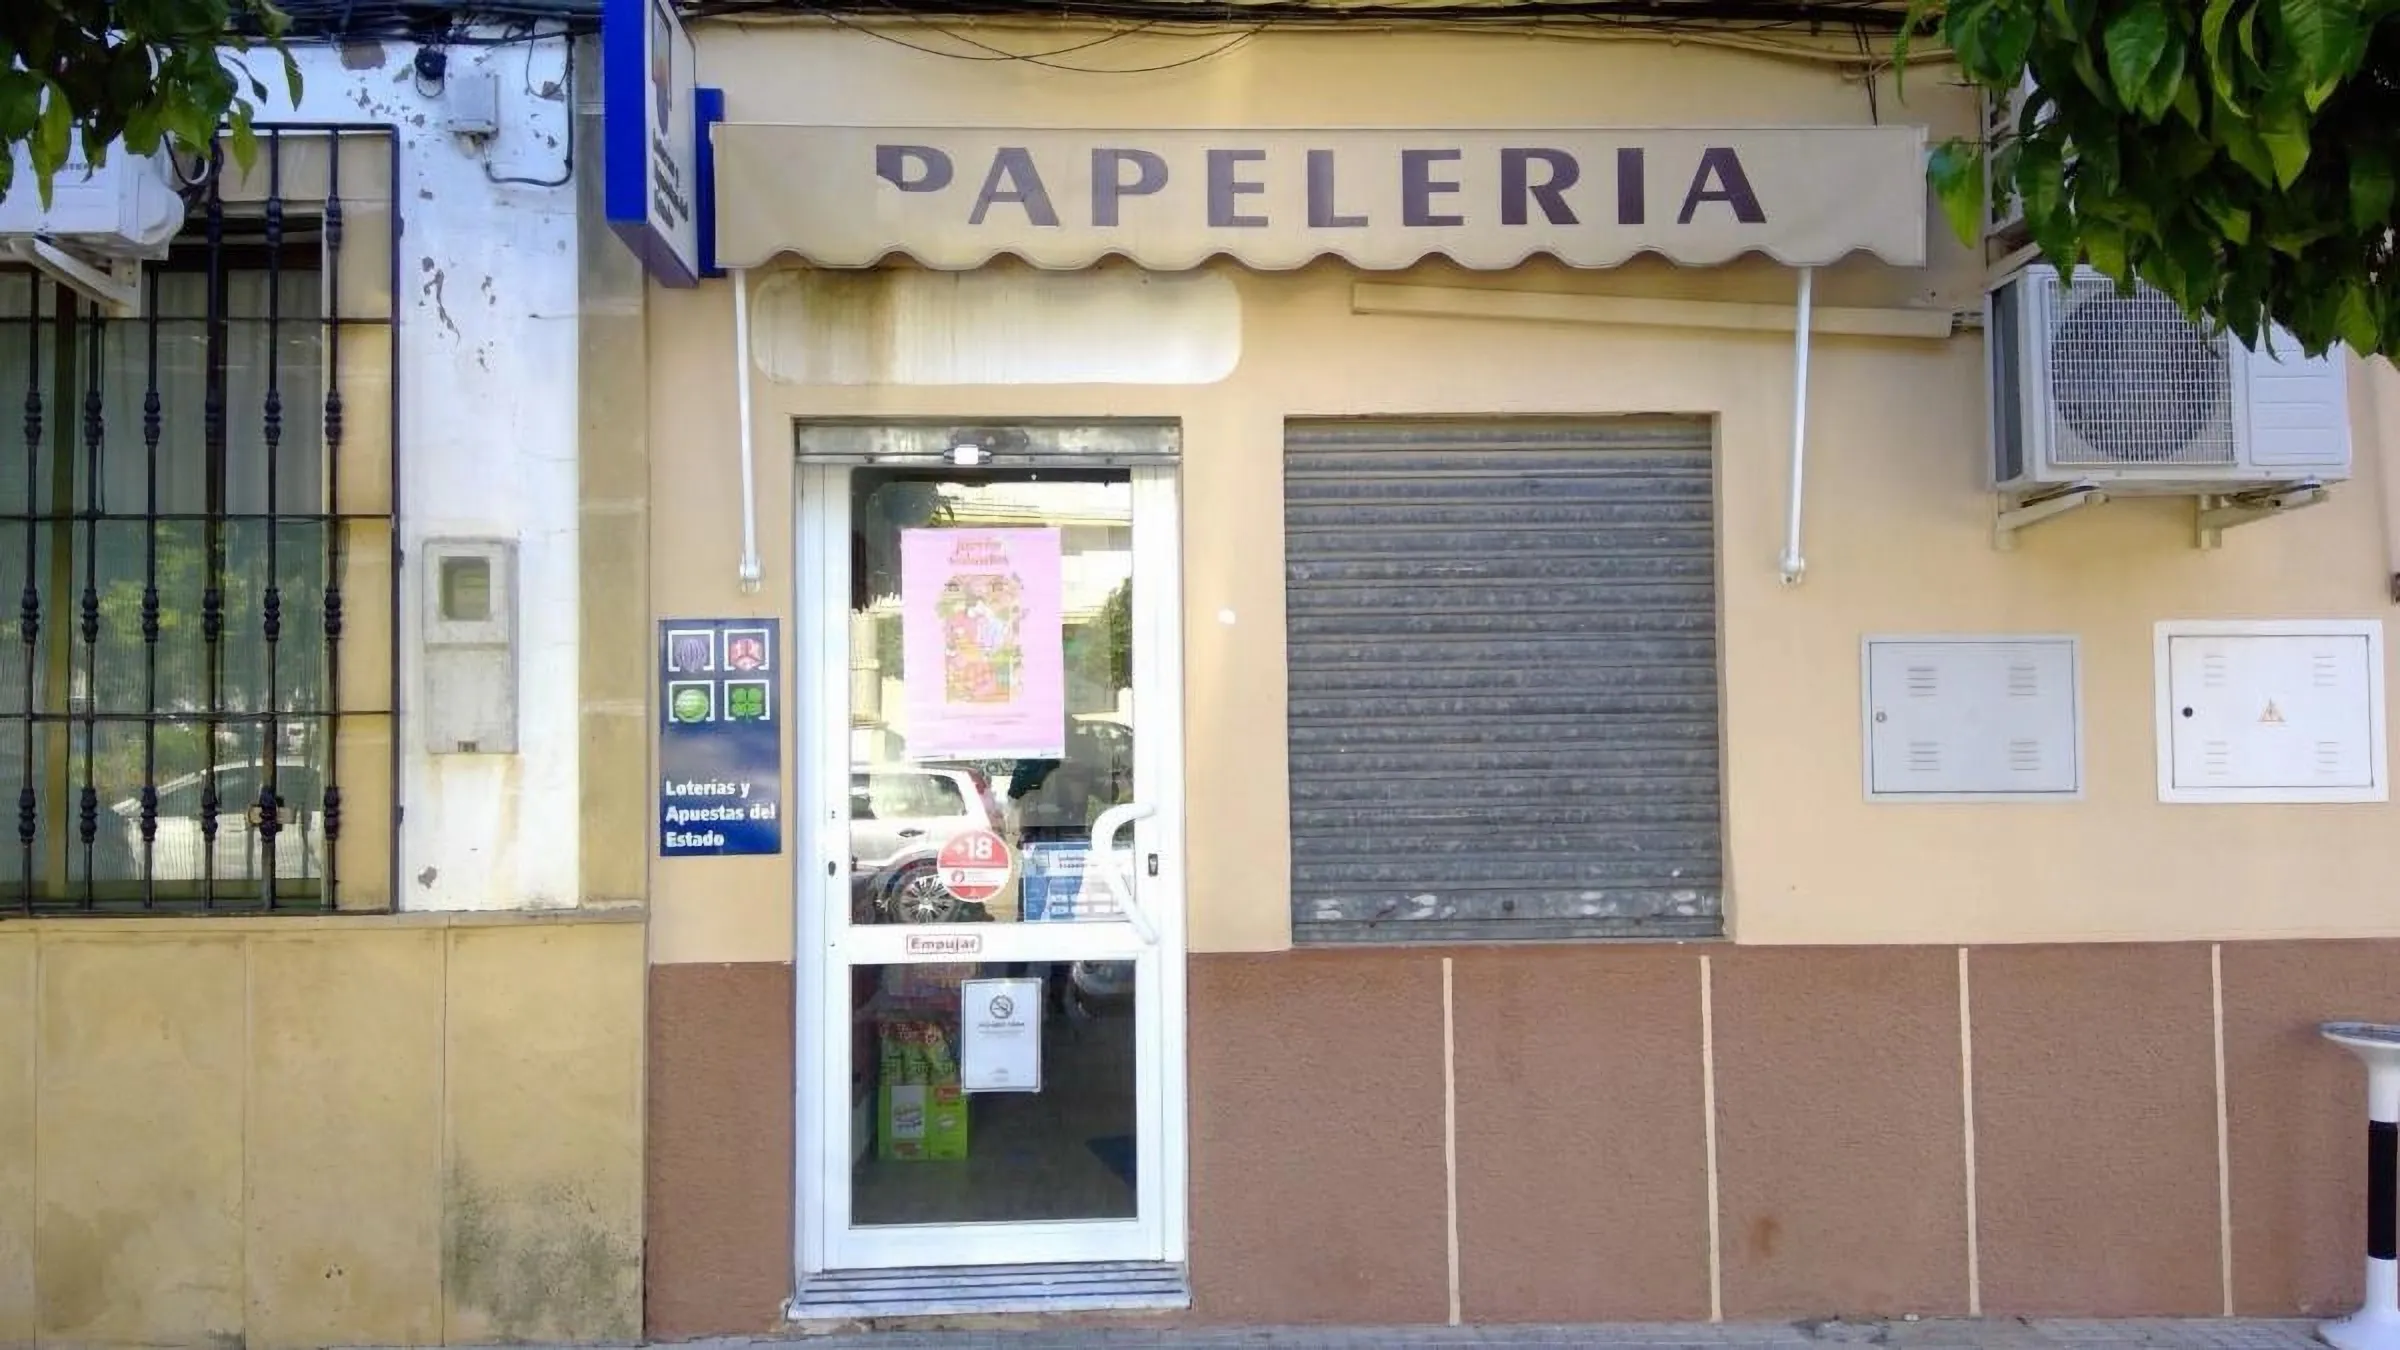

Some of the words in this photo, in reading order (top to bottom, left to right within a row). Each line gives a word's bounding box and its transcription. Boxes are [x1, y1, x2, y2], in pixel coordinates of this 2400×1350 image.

[876, 144, 1767, 227] PAPELERIA
[740, 781, 751, 799] y
[665, 805, 745, 825] Apuestas
[750, 802, 776, 819] del
[665, 830, 725, 847] Estado
[910, 936, 977, 952] Empujar
